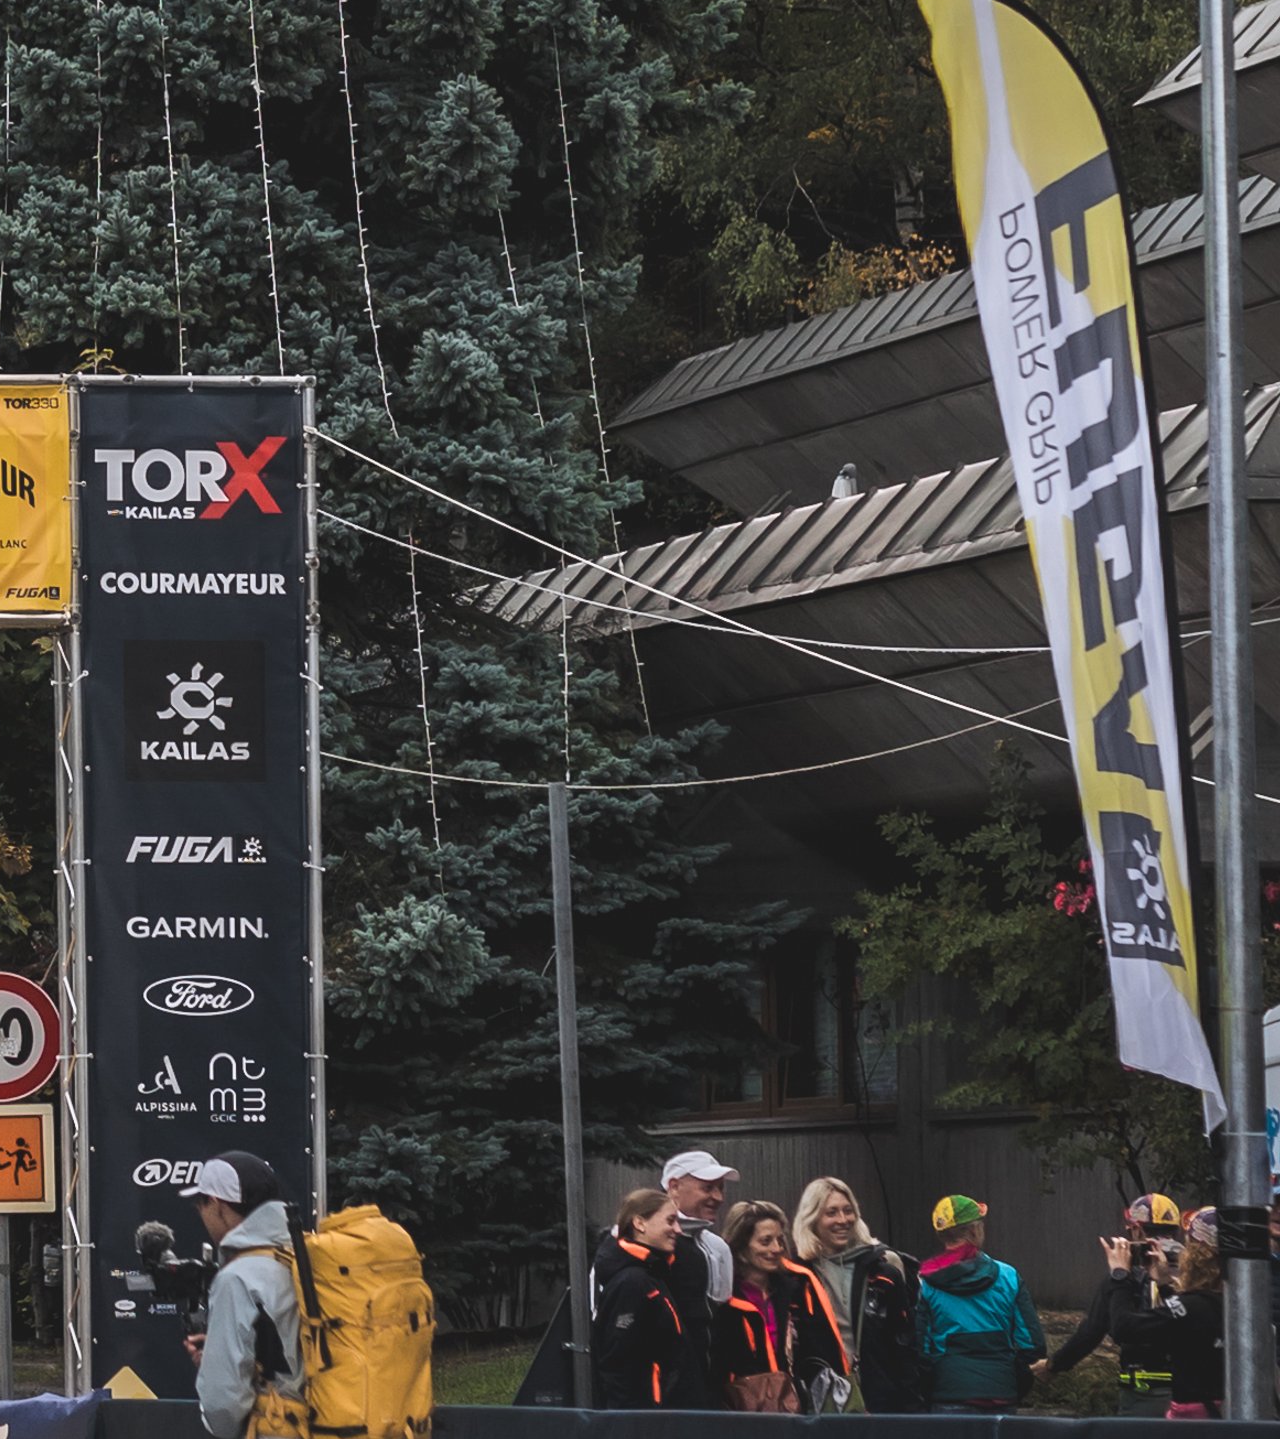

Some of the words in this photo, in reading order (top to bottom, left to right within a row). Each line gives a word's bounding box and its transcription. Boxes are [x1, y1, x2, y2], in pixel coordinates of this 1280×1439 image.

[3, 397, 59, 410] TOR330
[94, 436, 288, 519] TORX
[125, 507, 196, 520] KAILAS
[100, 572, 287, 595] COURMAYEUR
[5, 587, 47, 601] FUGA
[141, 741, 250, 760] KAILAS
[125, 836, 233, 863] FUGA
[165, 980, 233, 1009] Ford
[135, 1101, 197, 1112] ALPISSIMA
